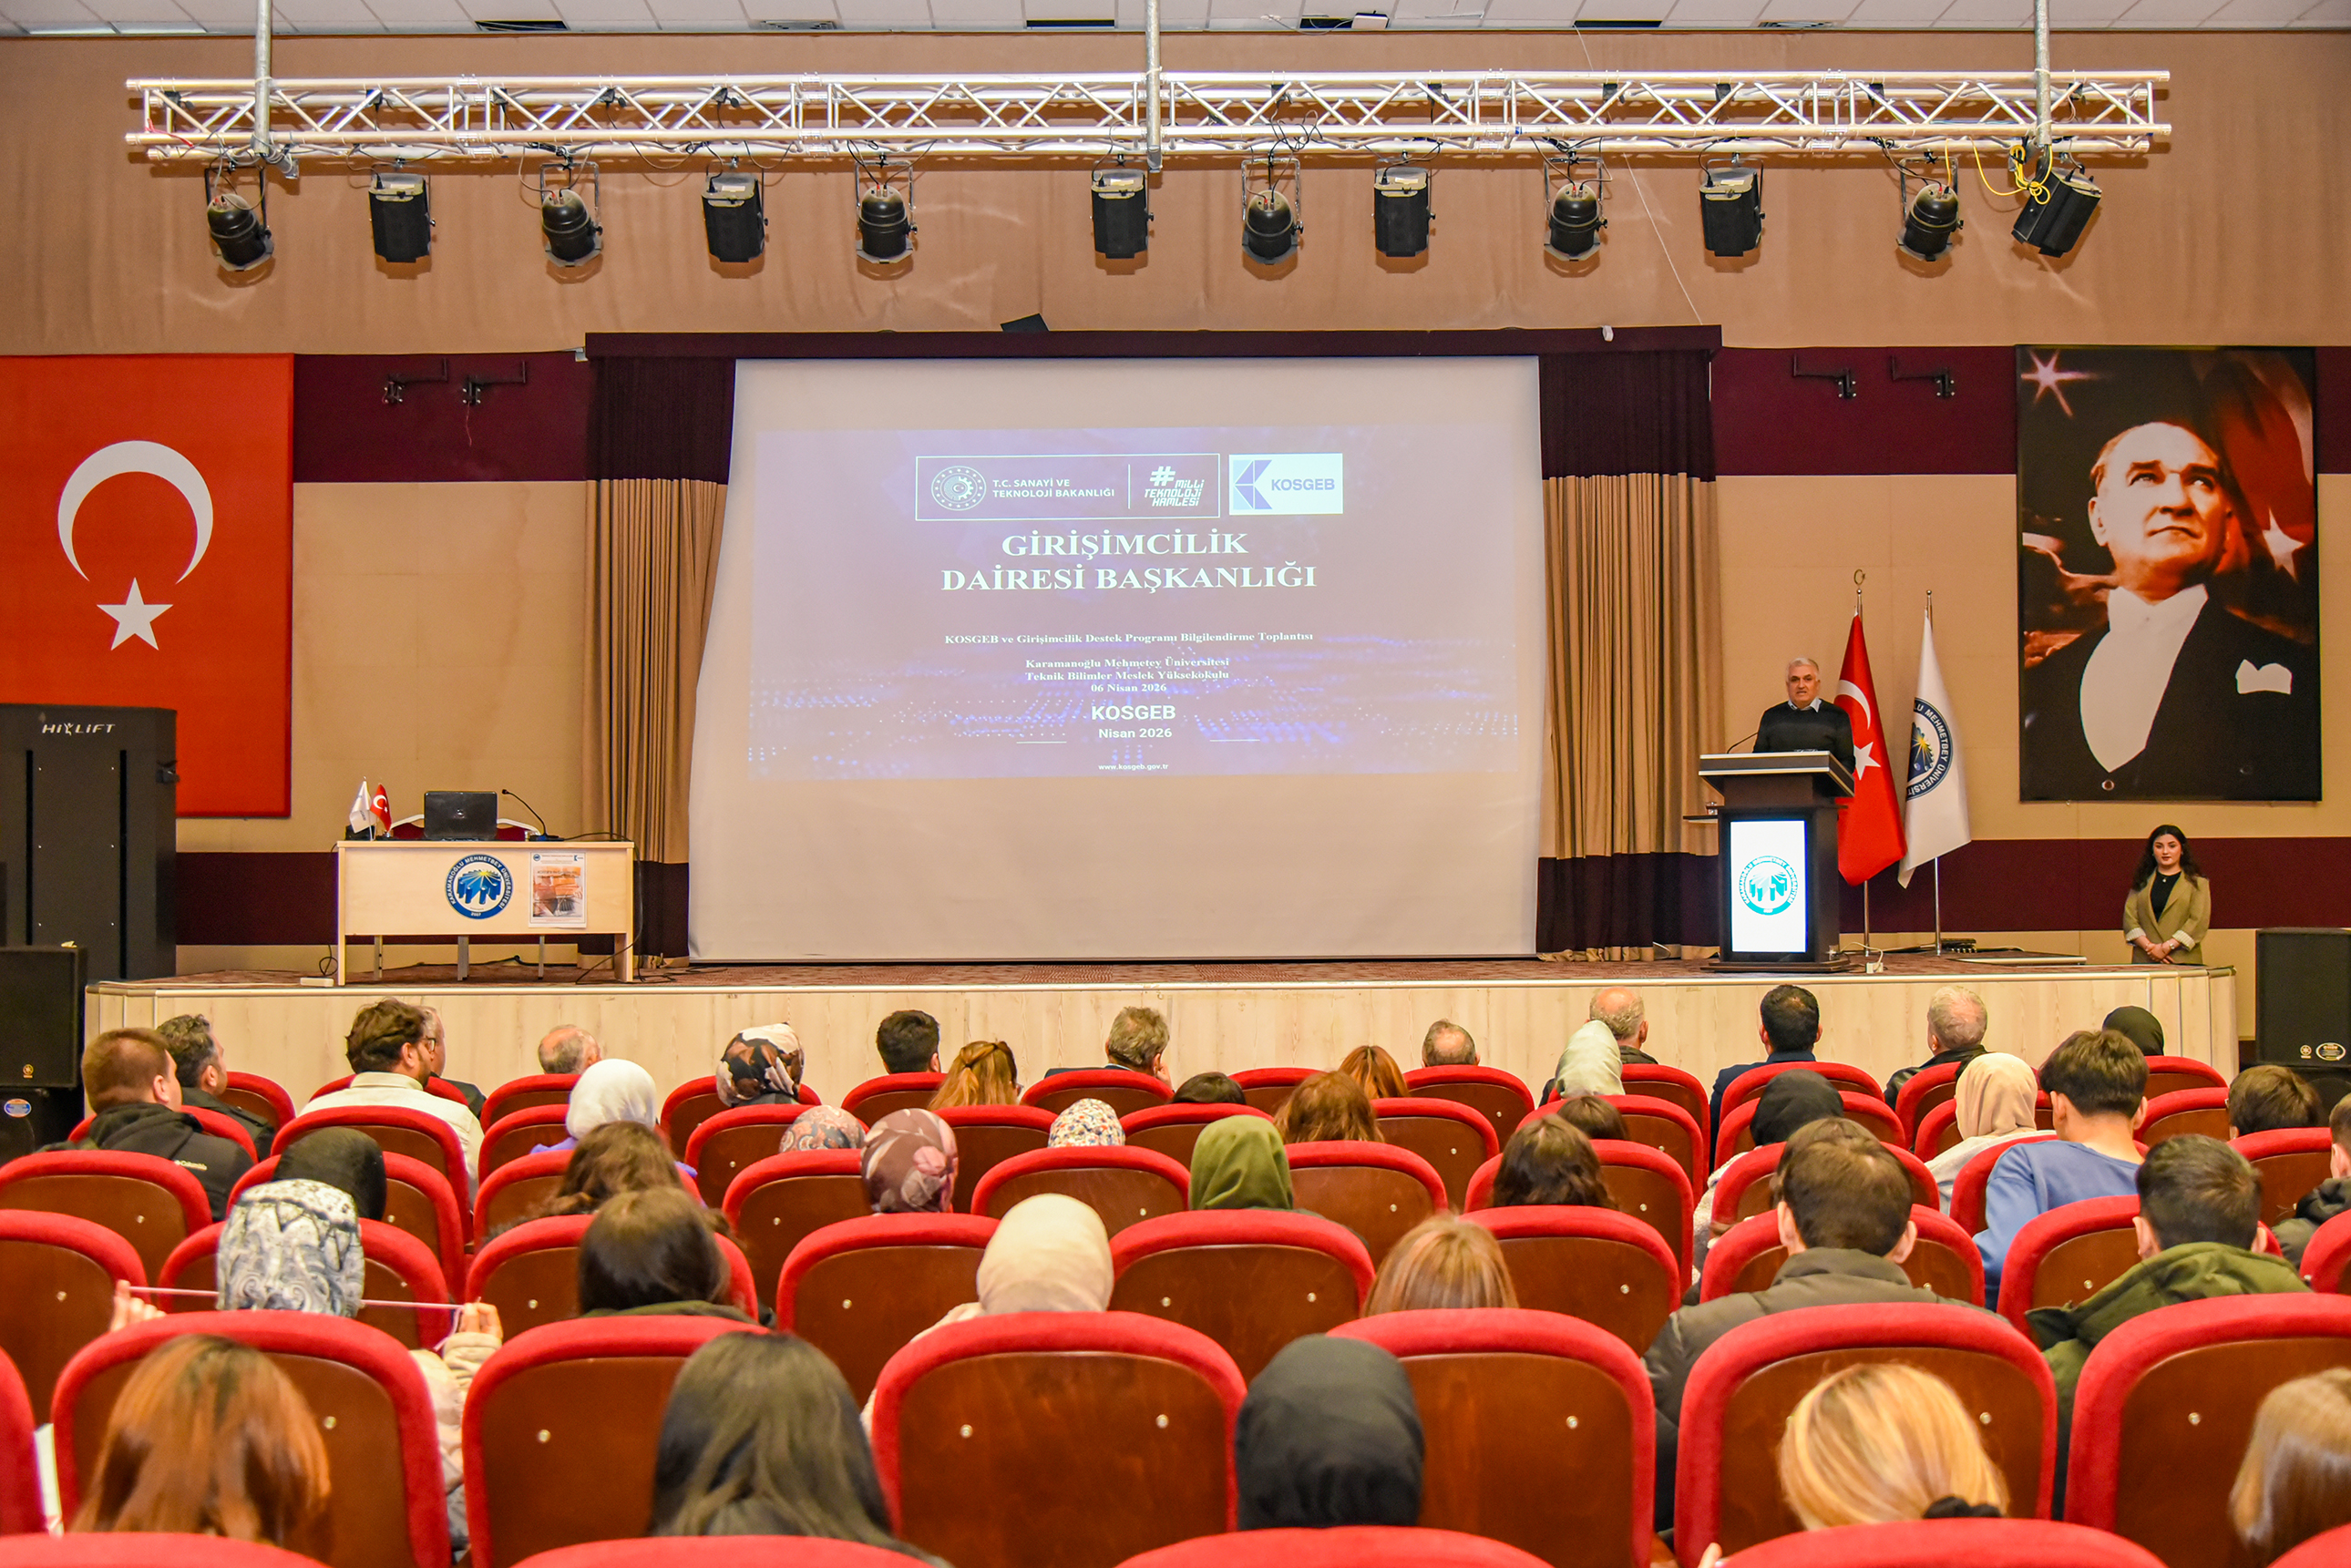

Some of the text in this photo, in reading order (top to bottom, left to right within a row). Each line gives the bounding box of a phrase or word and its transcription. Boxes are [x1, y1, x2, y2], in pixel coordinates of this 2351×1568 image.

[992, 477, 1070, 487] T.C. SANAYİ VE
[1271, 478, 1335, 491] KOSGEB
[992, 487, 1114, 497] TEKNOLOJİ BAKANLIĞI
[1001, 528, 1249, 560] GİRİŞİMCİLİK
[940, 560, 1318, 594] DAİRESİ BAŞKANLIĞI
[944, 634, 999, 644] KOSGEB
[1016, 634, 1083, 645] Girişimcilik
[1085, 633, 1123, 643] Destek
[1124, 633, 1177, 644] Programı
[1180, 632, 1256, 643] Bilgilendirme
[1258, 631, 1314, 642] Toplantısı
[1025, 659, 1101, 670] Karamanoğlu
[1165, 656, 1229, 667] Üniversitesi
[1025, 670, 1229, 681] Teknik Bilimler Meslek Yüksekokulu
[1091, 683, 1167, 692] 06 Nisan 2026
[1092, 705, 1176, 720] KOSGEB
[1098, 728, 1173, 739] Nisan 2026
[1925, 709, 1949, 762] MEHMETBEY
[1098, 764, 1169, 772] www.kosgeb.gov.tr
[464, 856, 502, 868] MEHMETBEY
